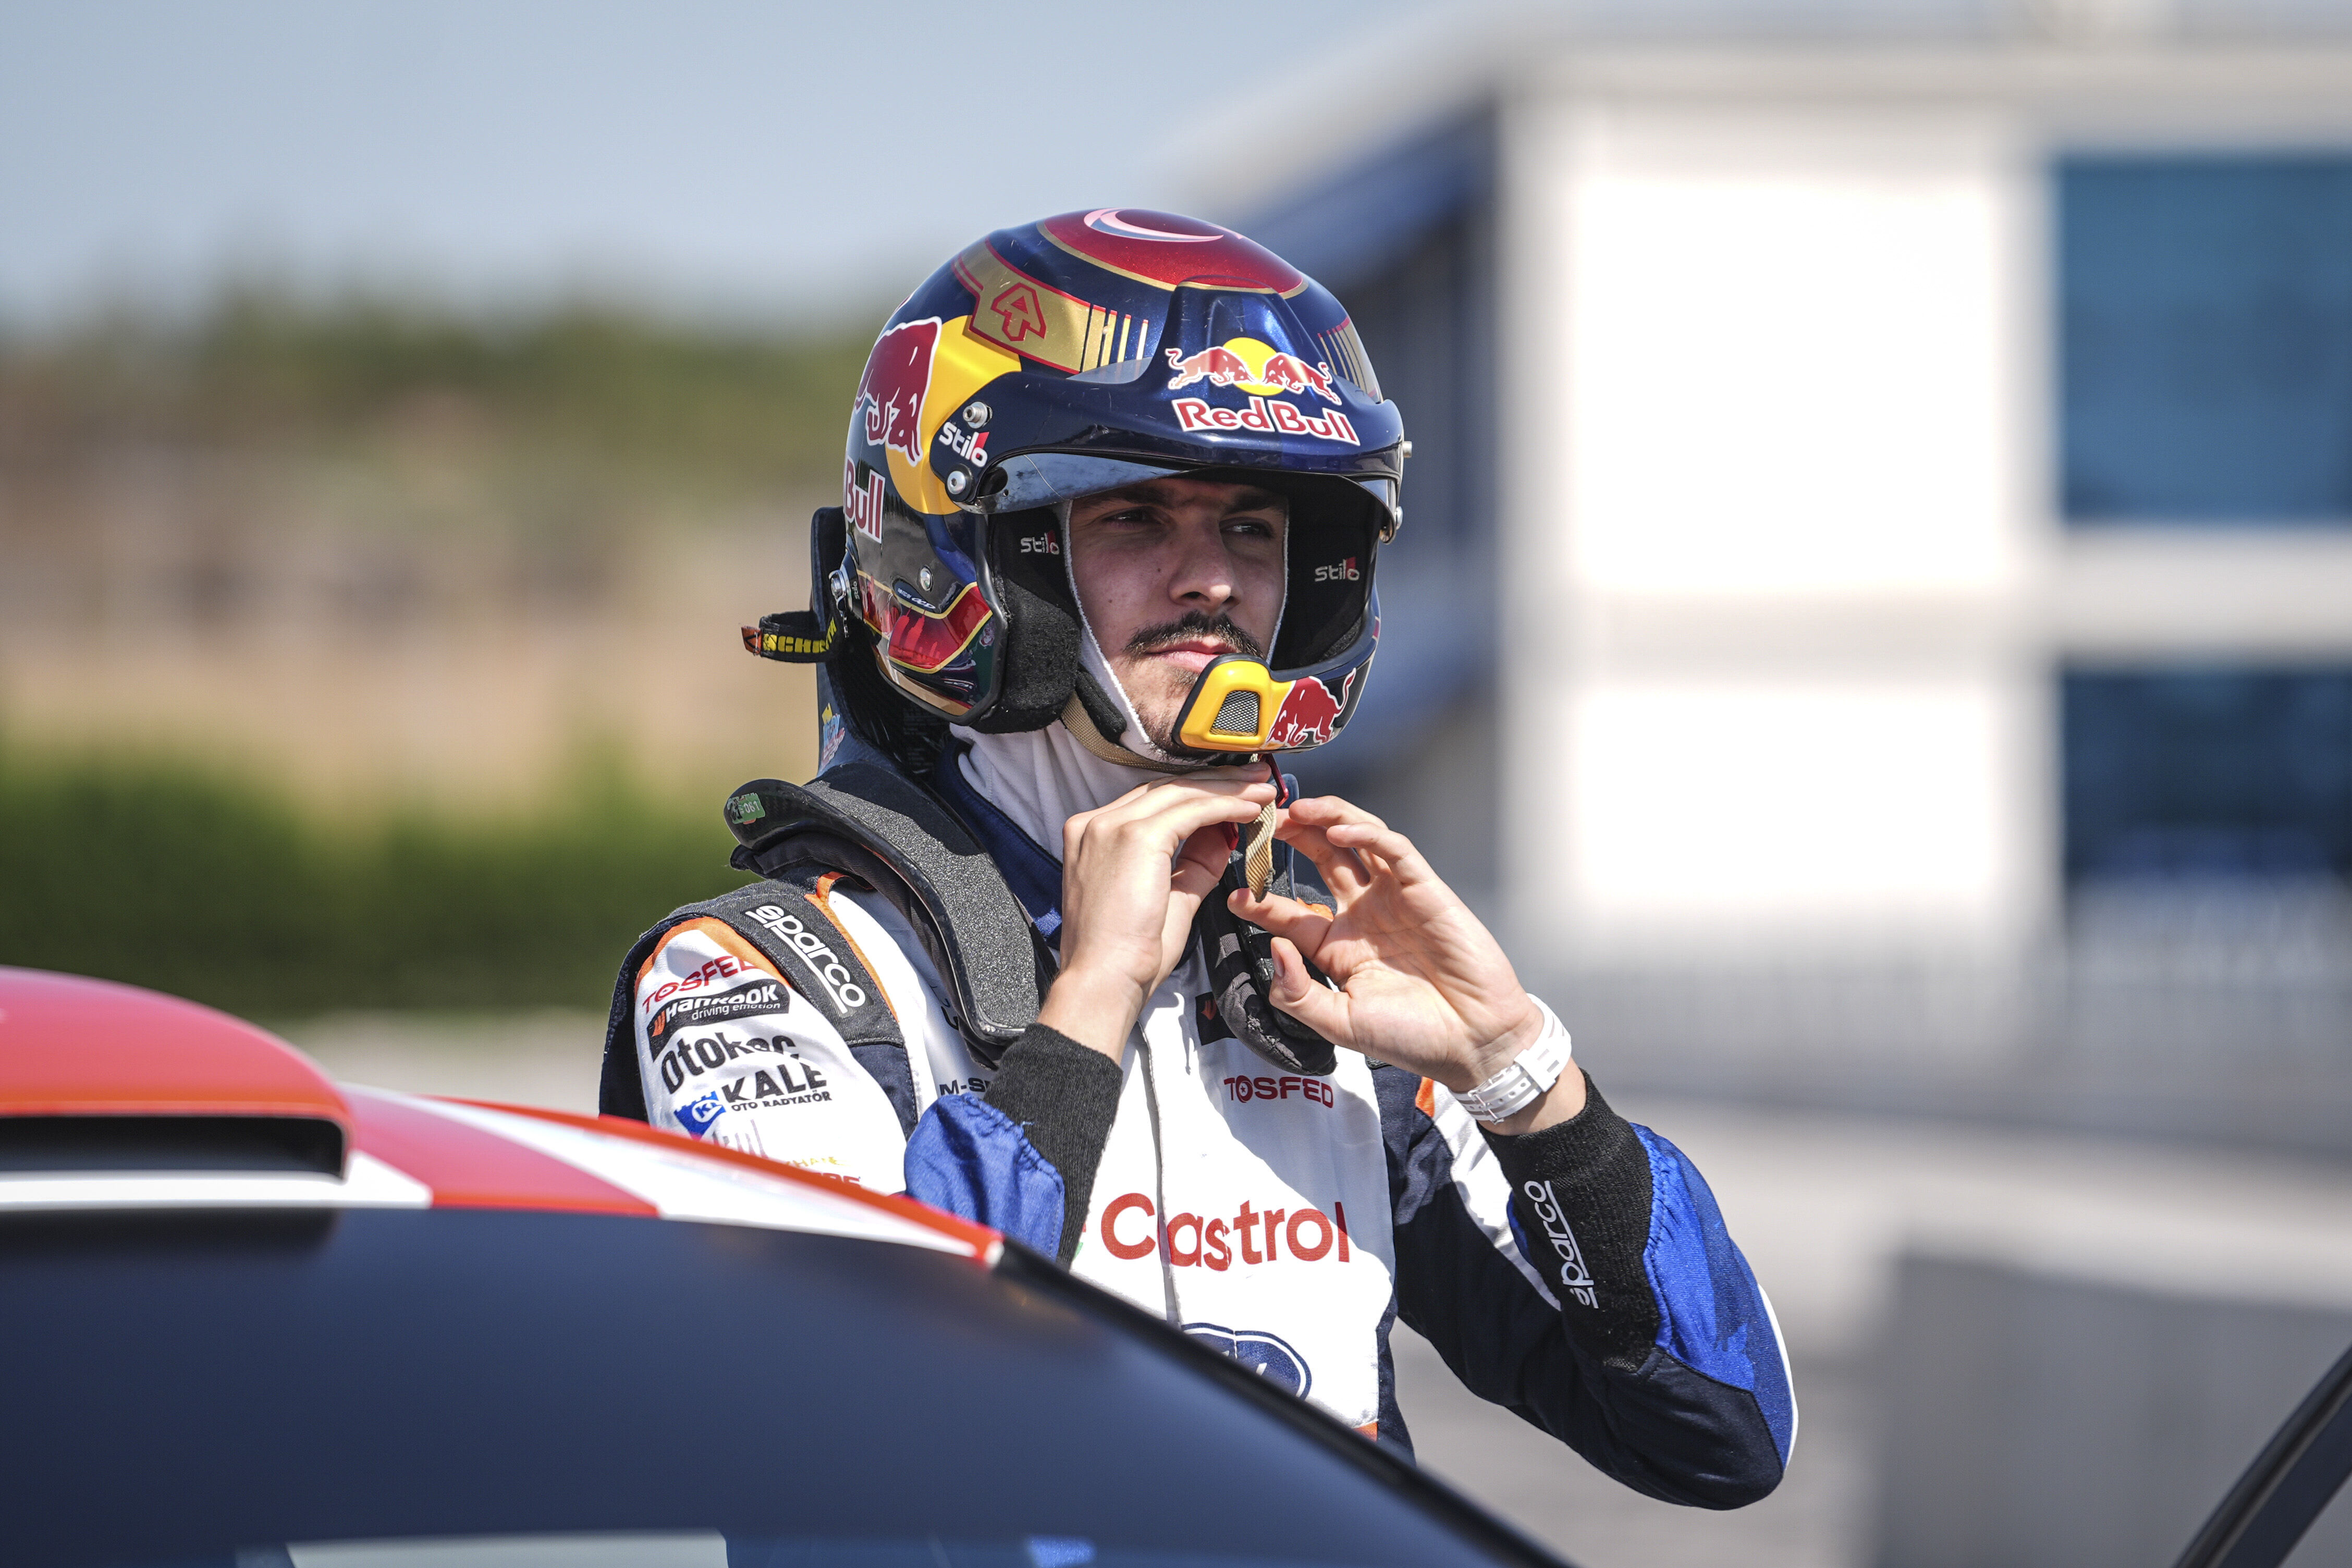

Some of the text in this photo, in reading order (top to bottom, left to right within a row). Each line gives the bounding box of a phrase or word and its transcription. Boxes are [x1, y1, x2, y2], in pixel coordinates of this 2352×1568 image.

[1174, 397, 1358, 444] Red Bull
[844, 457, 885, 542] Bull
[755, 904, 866, 1008] sparco
[691, 1002, 781, 1021] driving emotion
[721, 1062, 827, 1104] KALE
[731, 1090, 832, 1111] OTO RADYATÖR
[1223, 1075, 1334, 1108] TOSFED
[1100, 1192, 1350, 1271] Castrol
[1524, 1180, 1595, 1307] sparco
